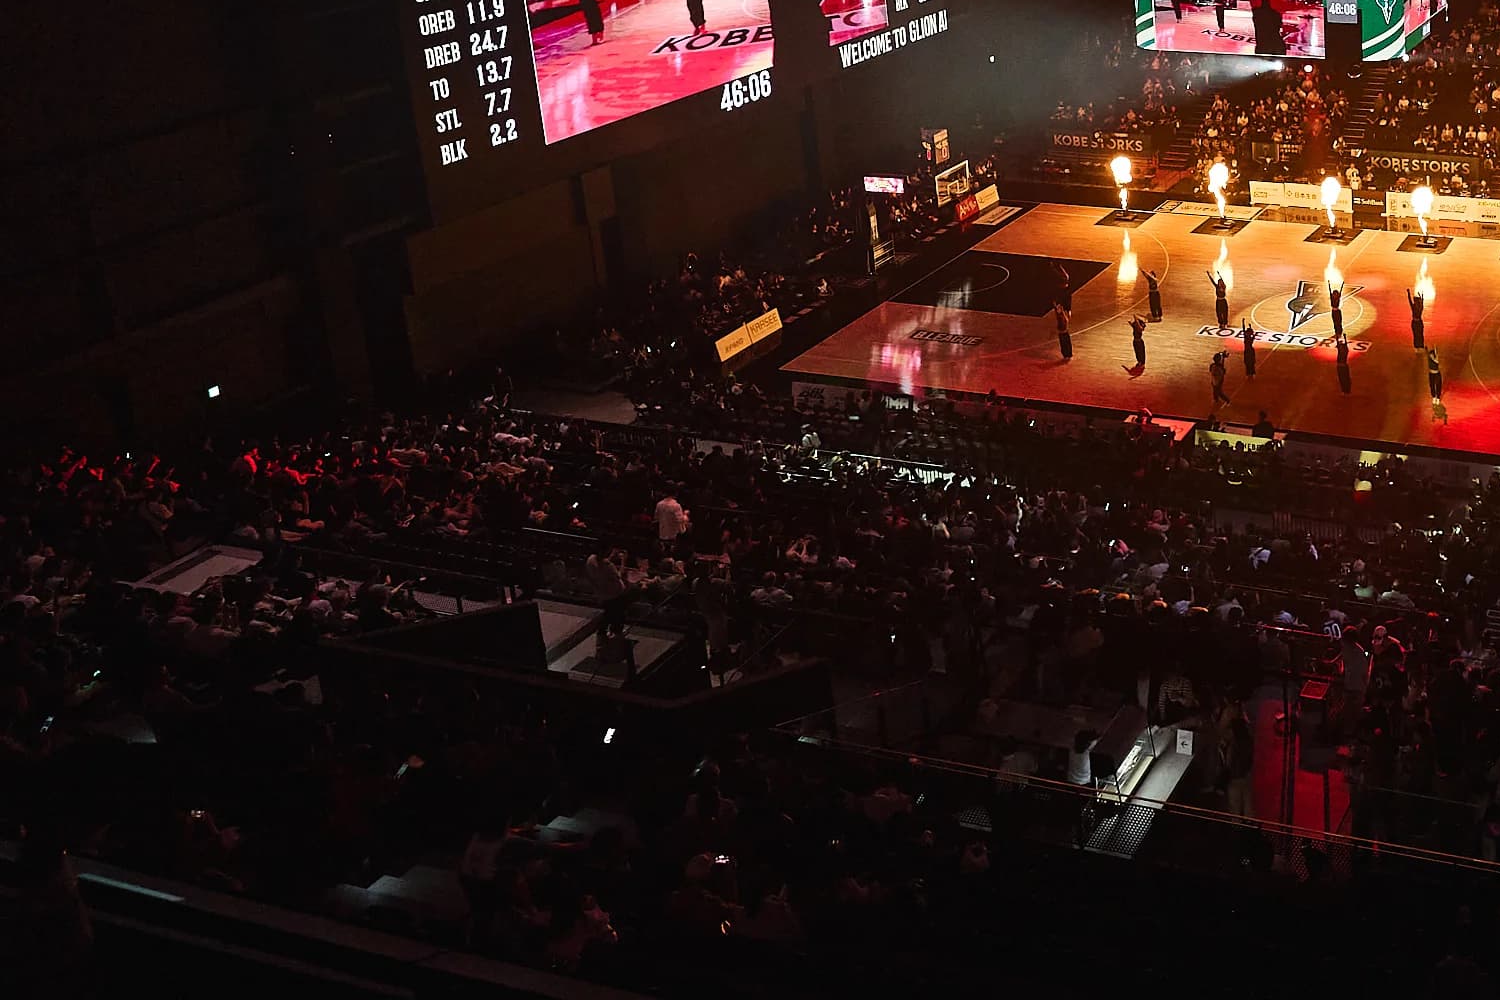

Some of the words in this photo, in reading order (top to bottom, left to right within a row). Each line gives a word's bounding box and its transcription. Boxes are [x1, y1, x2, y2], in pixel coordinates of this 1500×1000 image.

[418, 10, 455, 36] OREB
[1328, 3, 1357, 16] 46:06
[469, 25, 508, 56] 24.7
[652, 25, 775, 53] KOBE
[838, 31, 892, 69] WELCOME
[891, 27, 907, 48] TO
[908, 15, 940, 43] GLION
[424, 41, 461, 69] DREB
[476, 56, 513, 87] 13.7
[429, 78, 450, 101] TO
[484, 87, 512, 116] 7.7
[720, 69, 772, 112] 46:06
[435, 108, 462, 133] STL
[490, 118, 518, 147] 2.2
[440, 138, 469, 166] BLK
[1053, 134, 1088, 147] KOBE
[1411, 158, 1470, 174] STORKS
